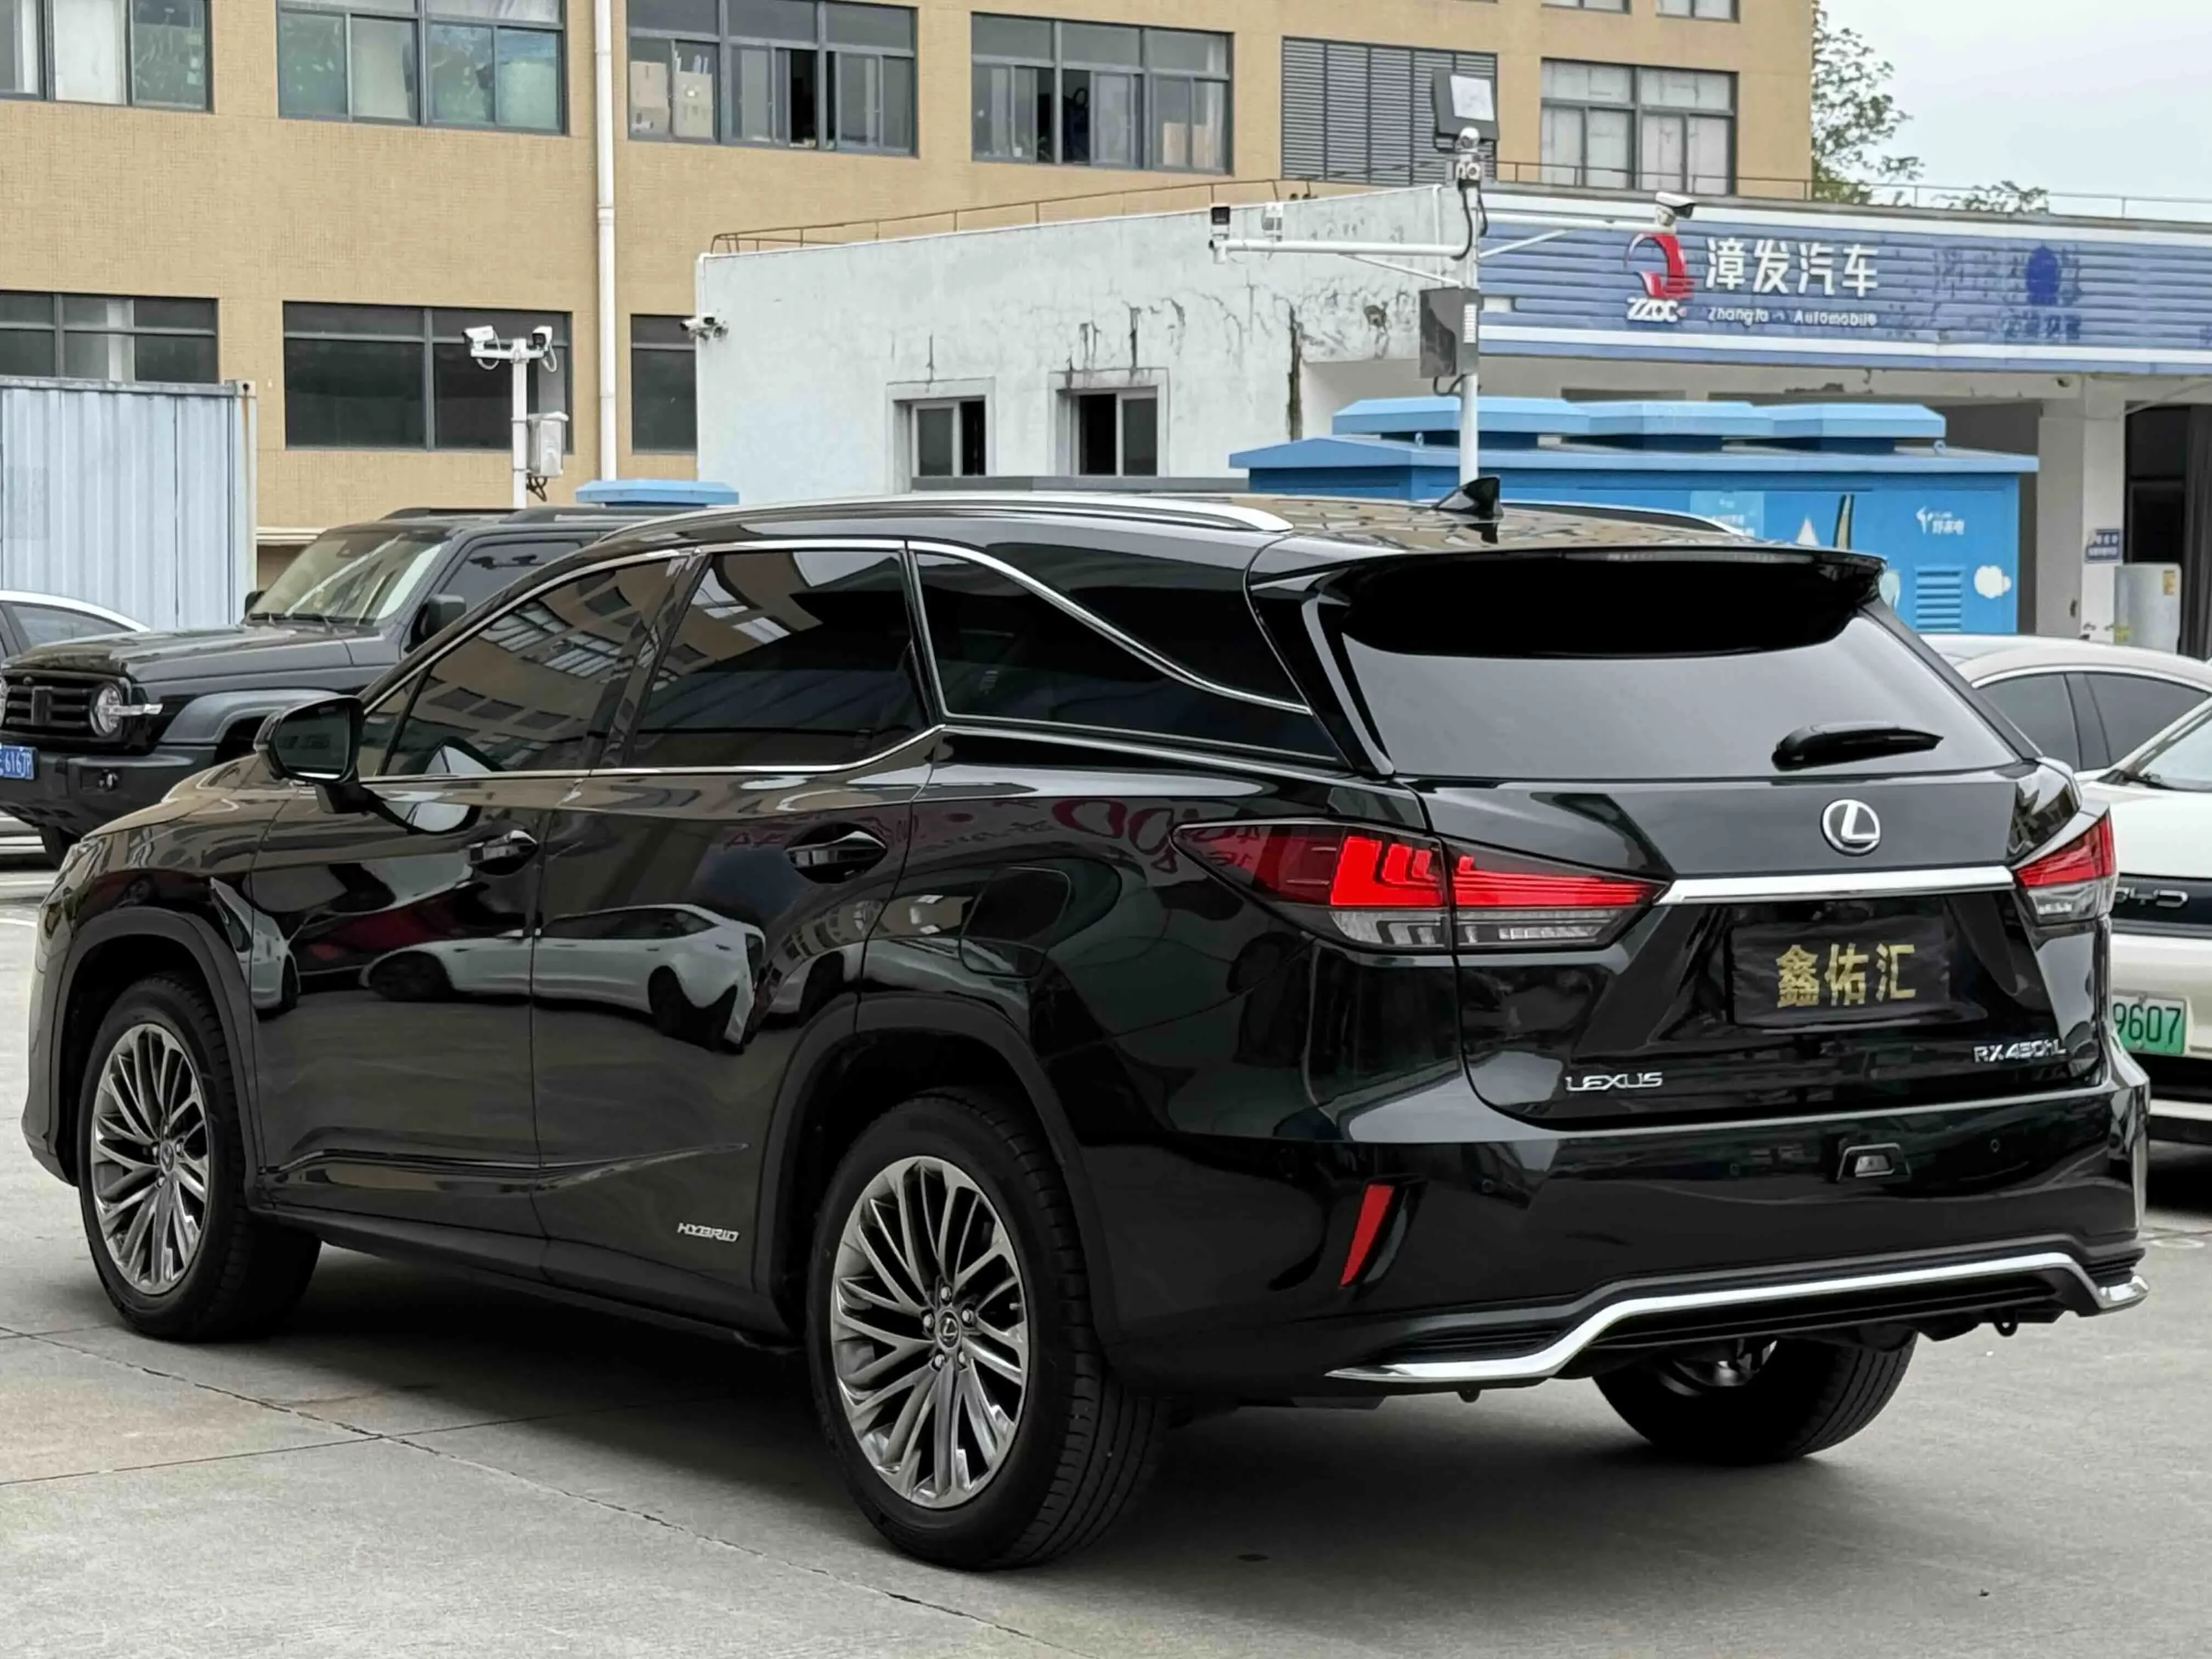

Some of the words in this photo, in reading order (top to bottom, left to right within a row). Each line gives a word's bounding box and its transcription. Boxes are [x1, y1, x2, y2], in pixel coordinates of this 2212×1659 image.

[1706, 238, 1878, 297] 漳发汽车
[1793, 309, 1877, 326] Automobile
[1776, 943, 1916, 1008] 鑫佑汇
[2113, 1002, 2181, 1045] 9607
[1565, 1072, 1663, 1091] LEXUS
[677, 1222, 740, 1242] HYBRID
